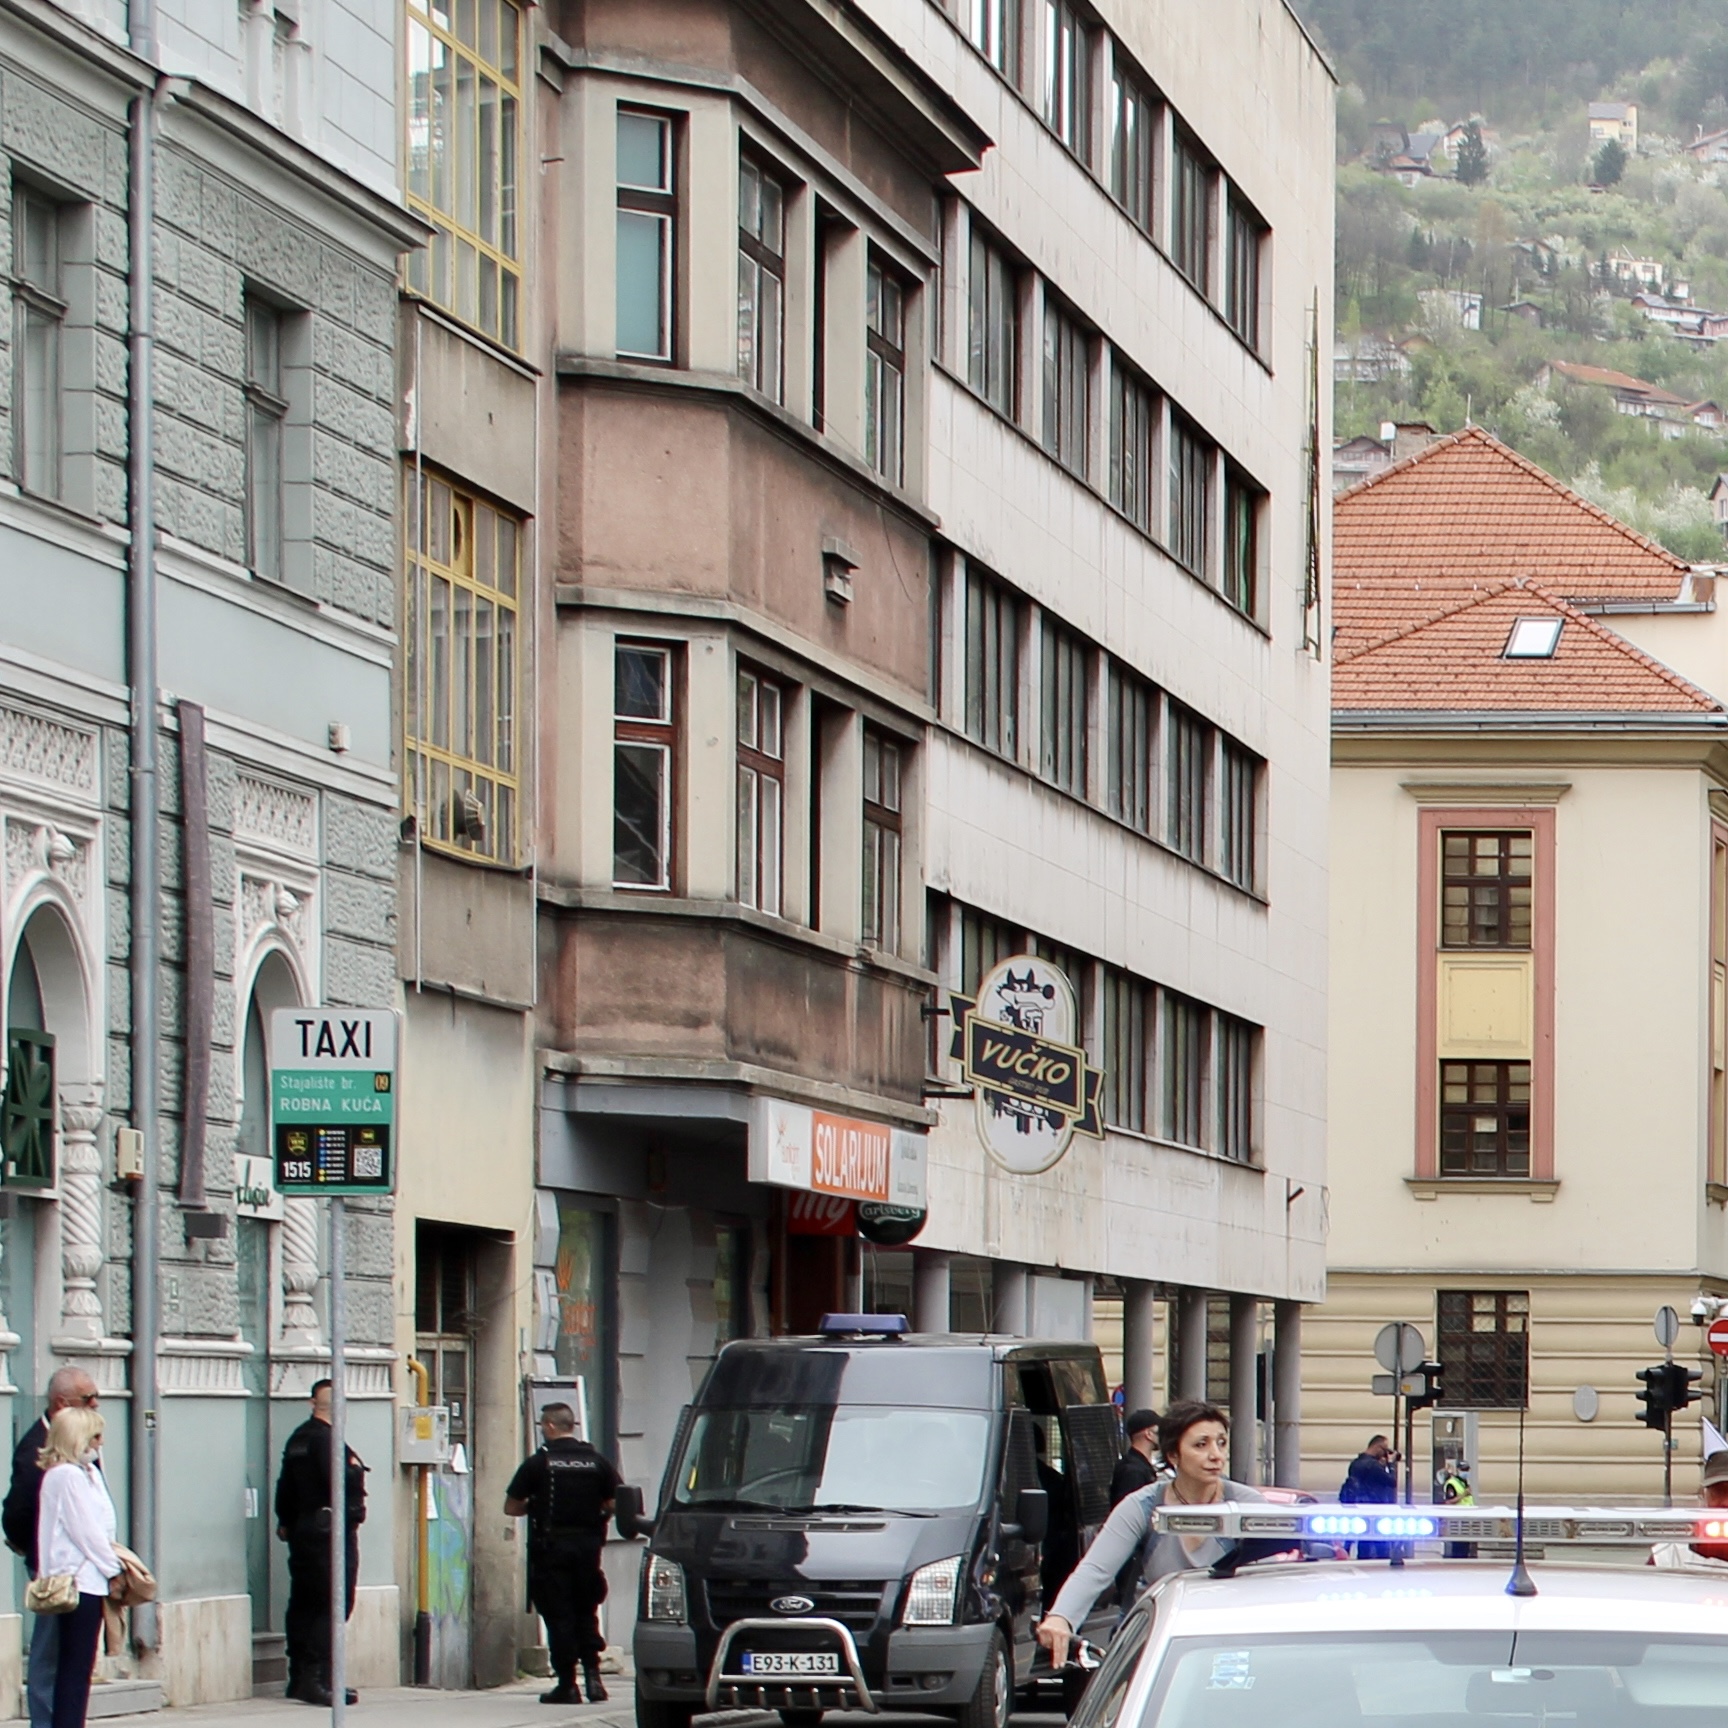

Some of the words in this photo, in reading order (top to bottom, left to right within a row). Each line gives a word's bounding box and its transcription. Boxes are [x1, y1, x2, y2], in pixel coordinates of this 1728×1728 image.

[295, 1019, 372, 1058] TAXI
[981, 1039, 1071, 1085] VUČKO
[280, 1075, 335, 1092] Stajalište
[341, 1076, 357, 1090] br.
[374, 1074, 389, 1091] 09
[280, 1097, 332, 1112] ROBNA
[342, 1096, 383, 1112] KUĆA
[815, 1123, 887, 1195] SOLARIJUM
[283, 1161, 312, 1178] 1515
[753, 1655, 836, 1672] E93-K-131
